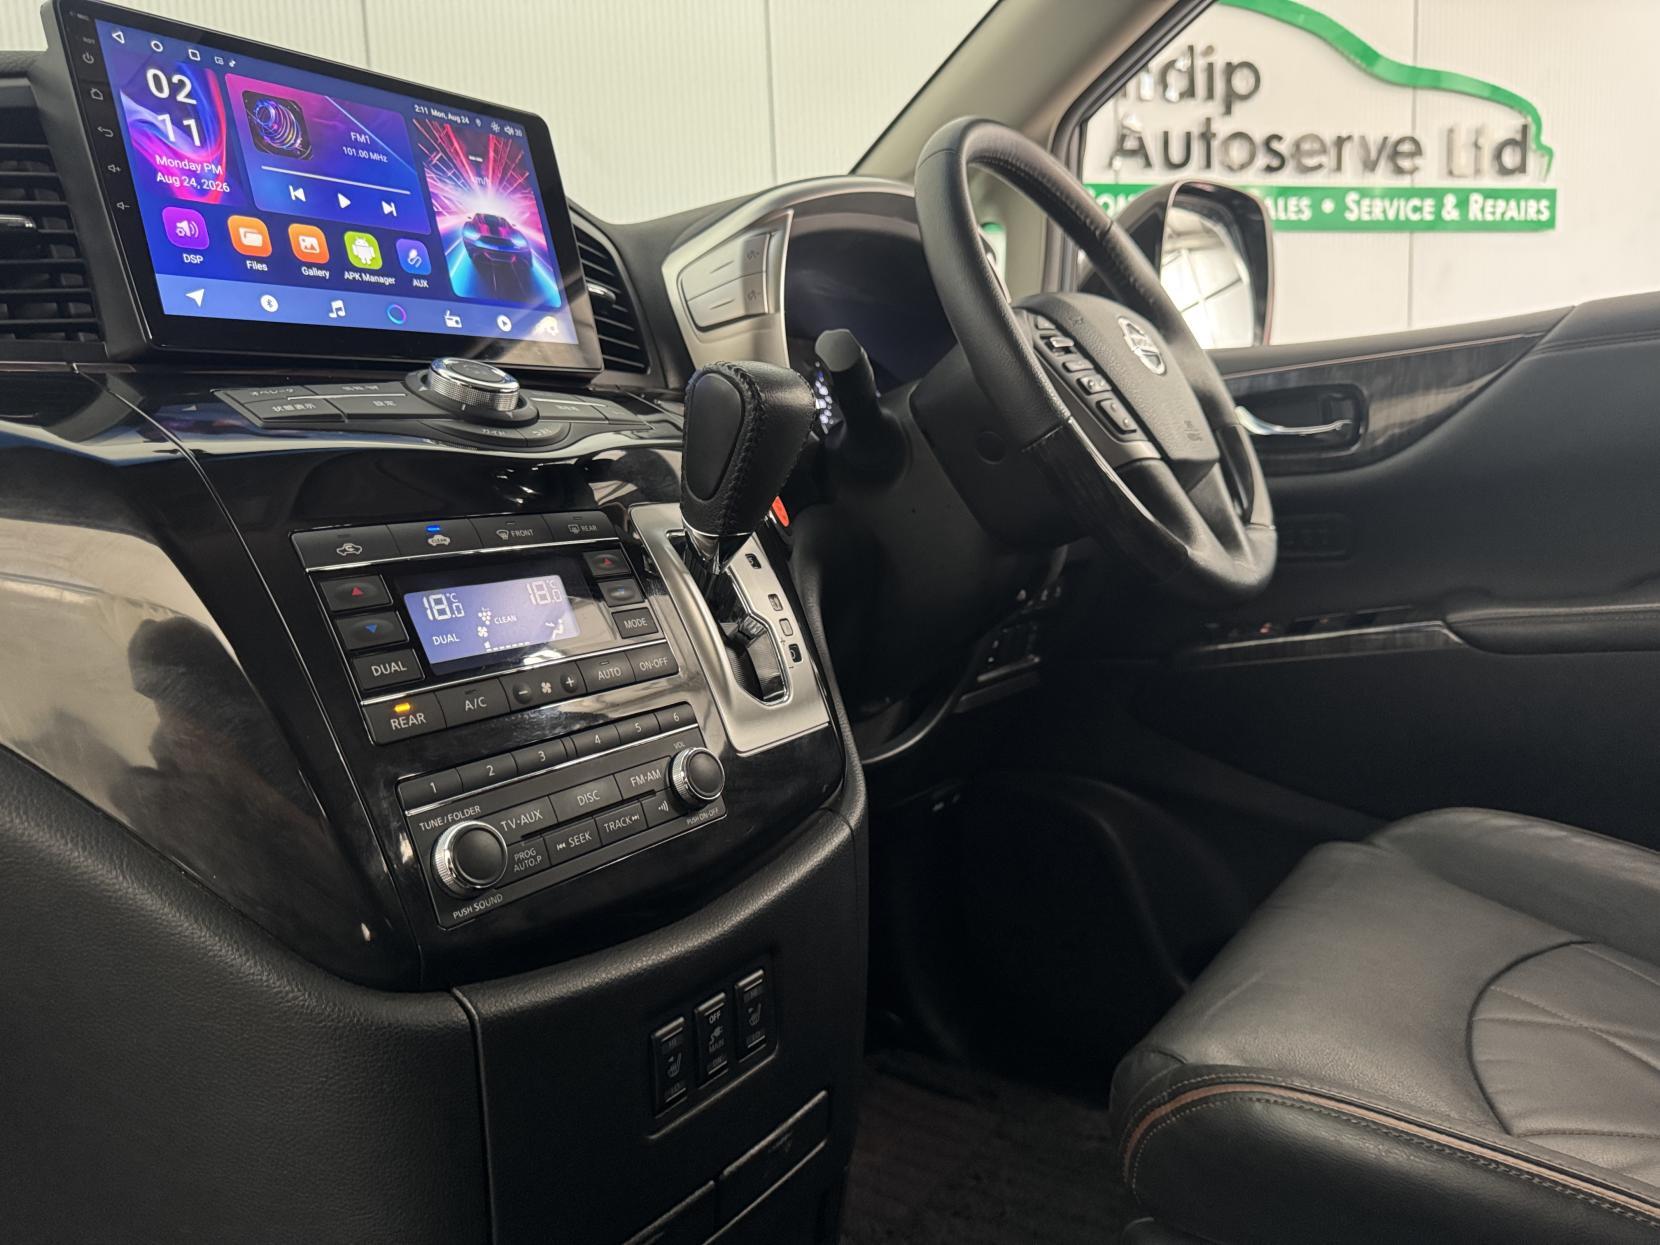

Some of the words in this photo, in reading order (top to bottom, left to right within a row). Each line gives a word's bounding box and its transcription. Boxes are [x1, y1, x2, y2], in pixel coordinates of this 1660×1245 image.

[146, 68, 197, 105] 02
[414, 104, 429, 115] 2:11
[448, 112, 461, 124] Aug
[460, 116, 470, 124] 24
[157, 113, 201, 147] 11
[351, 132, 371, 145] FM1
[1109, 116, 1423, 175] Autoserve
[342, 146, 369, 160] 101.00
[370, 151, 388, 163] MHz
[155, 154, 202, 173] Monday
[203, 162, 223, 175] PM
[156, 172, 180, 188] Aug
[182, 175, 200, 190] 24,
[201, 178, 230, 193] 2026
[1263, 194, 1312, 221] ALES
[1344, 191, 1435, 222] SERVICE
[1441, 193, 1460, 222] &
[1468, 192, 1551, 222] REPAIRS
[183, 253, 203, 264] DSP
[246, 260, 268, 272] Files
[301, 266, 330, 280] Gallery
[344, 270, 361, 281] APK
[362, 272, 396, 286] Manager
[412, 278, 429, 288] AUX
[511, 529, 534, 538] FRONT
[494, 615, 517, 625] CLEAN
[624, 617, 648, 629] MODE
[432, 634, 460, 646] DUAL
[371, 661, 407, 677] DUAL
[598, 666, 622, 681] AUTO
[465, 696, 487, 712] A/C
[390, 712, 427, 731] REAR
[673, 713, 680, 722] 6
[635, 723, 642, 733] 5
[594, 735, 601, 745] 4
[538, 751, 546, 762] 3
[486, 765, 495, 777] 2
[430, 782, 437, 794] 1
[577, 790, 600, 806] DISC
[604, 816, 632, 833] TRACK
[568, 831, 592, 848] SEEK
[514, 848, 537, 861] PROG
[453, 905, 473, 920] PUSH
[473, 894, 503, 911] SOUND
[709, 1010, 721, 1024] OFF
